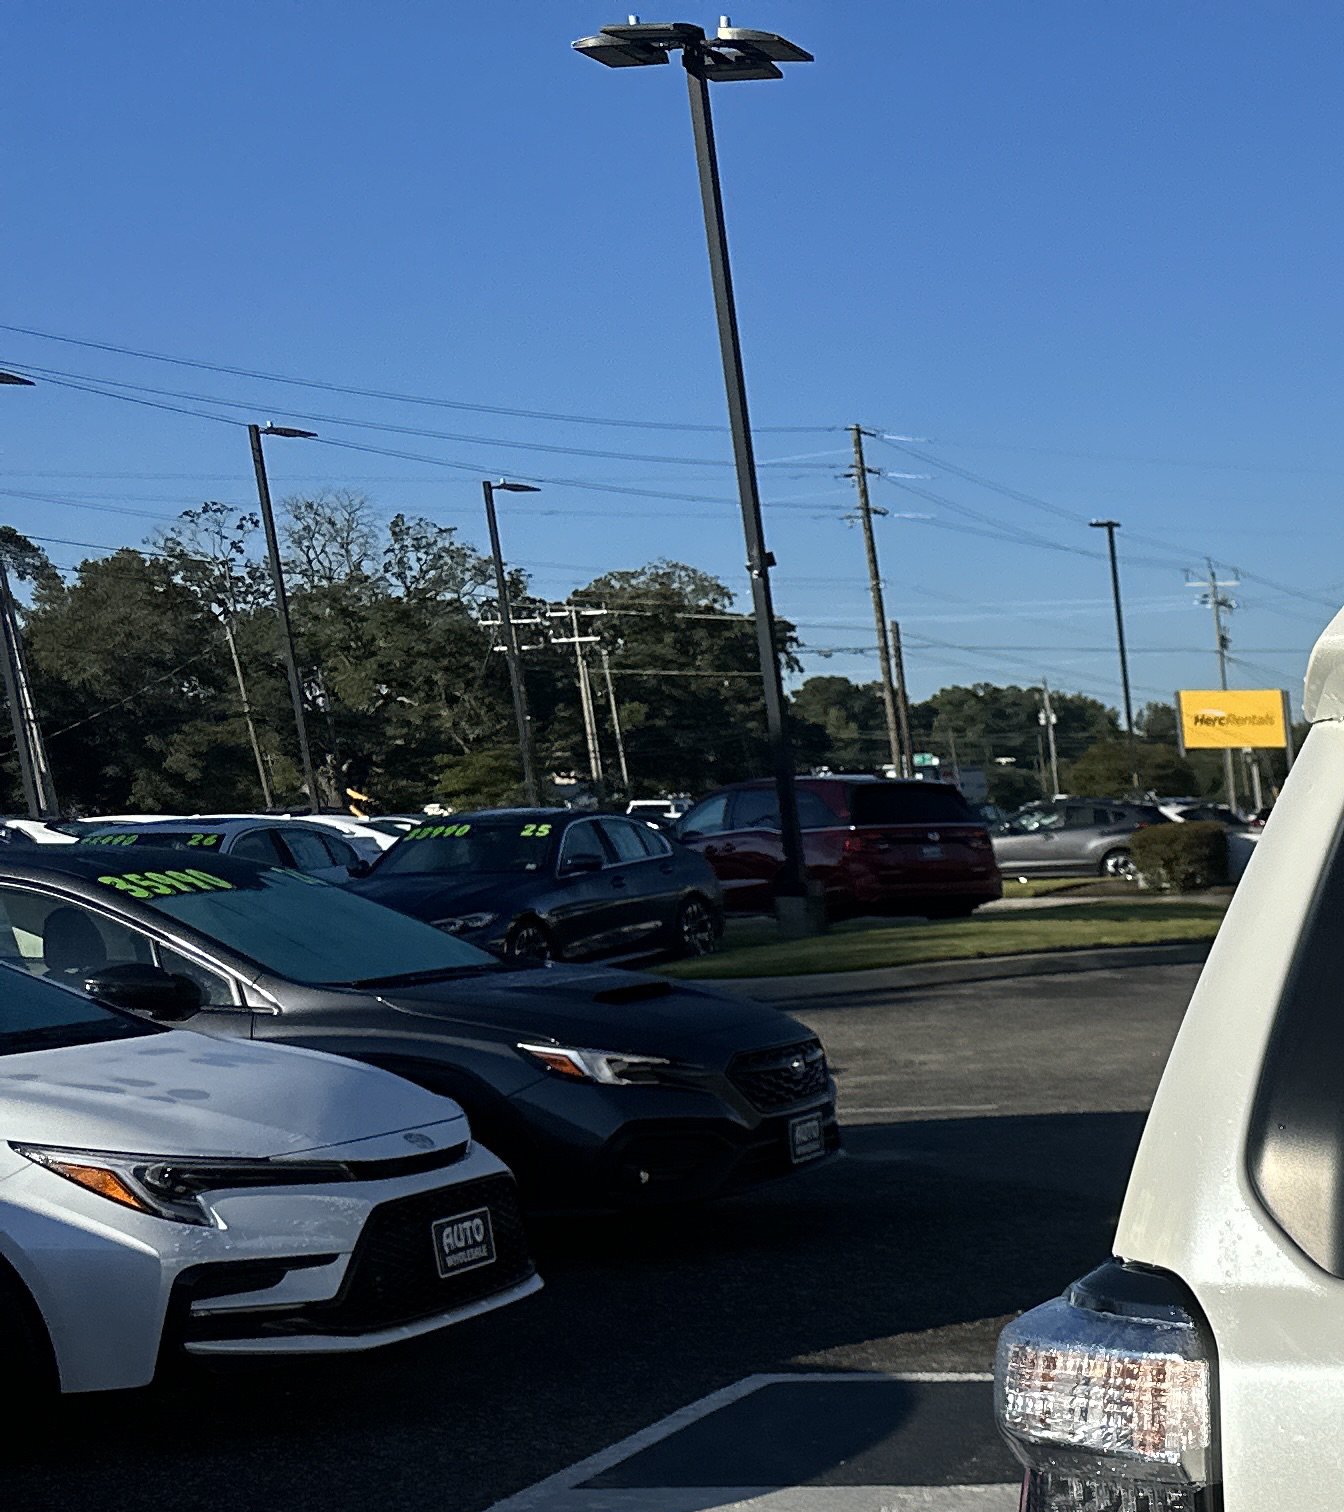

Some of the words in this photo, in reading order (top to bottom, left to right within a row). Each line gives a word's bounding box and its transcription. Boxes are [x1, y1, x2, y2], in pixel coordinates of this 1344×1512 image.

[186, 833, 217, 846] 26
[519, 823, 552, 837] 25
[98, 868, 235, 899] 35990
[442, 1218, 485, 1255] AUTO
